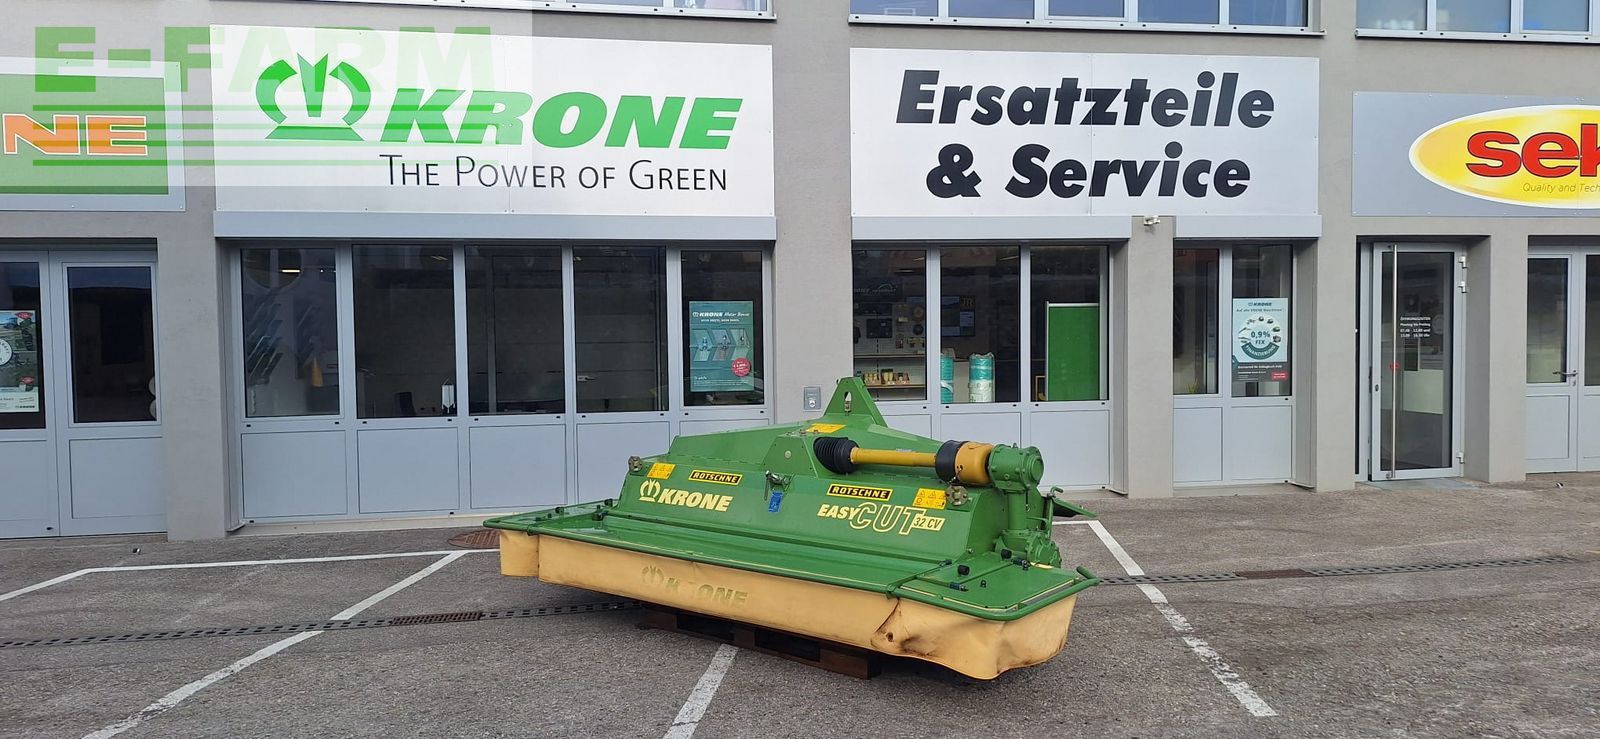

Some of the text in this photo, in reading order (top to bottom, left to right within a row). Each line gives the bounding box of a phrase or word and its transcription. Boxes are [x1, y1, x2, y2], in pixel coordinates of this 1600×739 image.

[897, 70, 1275, 128] Ersatzteile
[380, 87, 743, 149] KRONE
[927, 142, 1250, 198] & Service
[1523, 183, 1556, 194] Quality
[1559, 184, 1576, 192] and
[1251, 331, 1270, 339] 0,9%
[693, 472, 738, 483] ROTSCHNE
[658, 488, 733, 512] KRONE
[832, 486, 887, 498] ROTSCHNE
[914, 517, 925, 527] 32
[928, 518, 942, 529] CV
[664, 577, 748, 605] KONE
